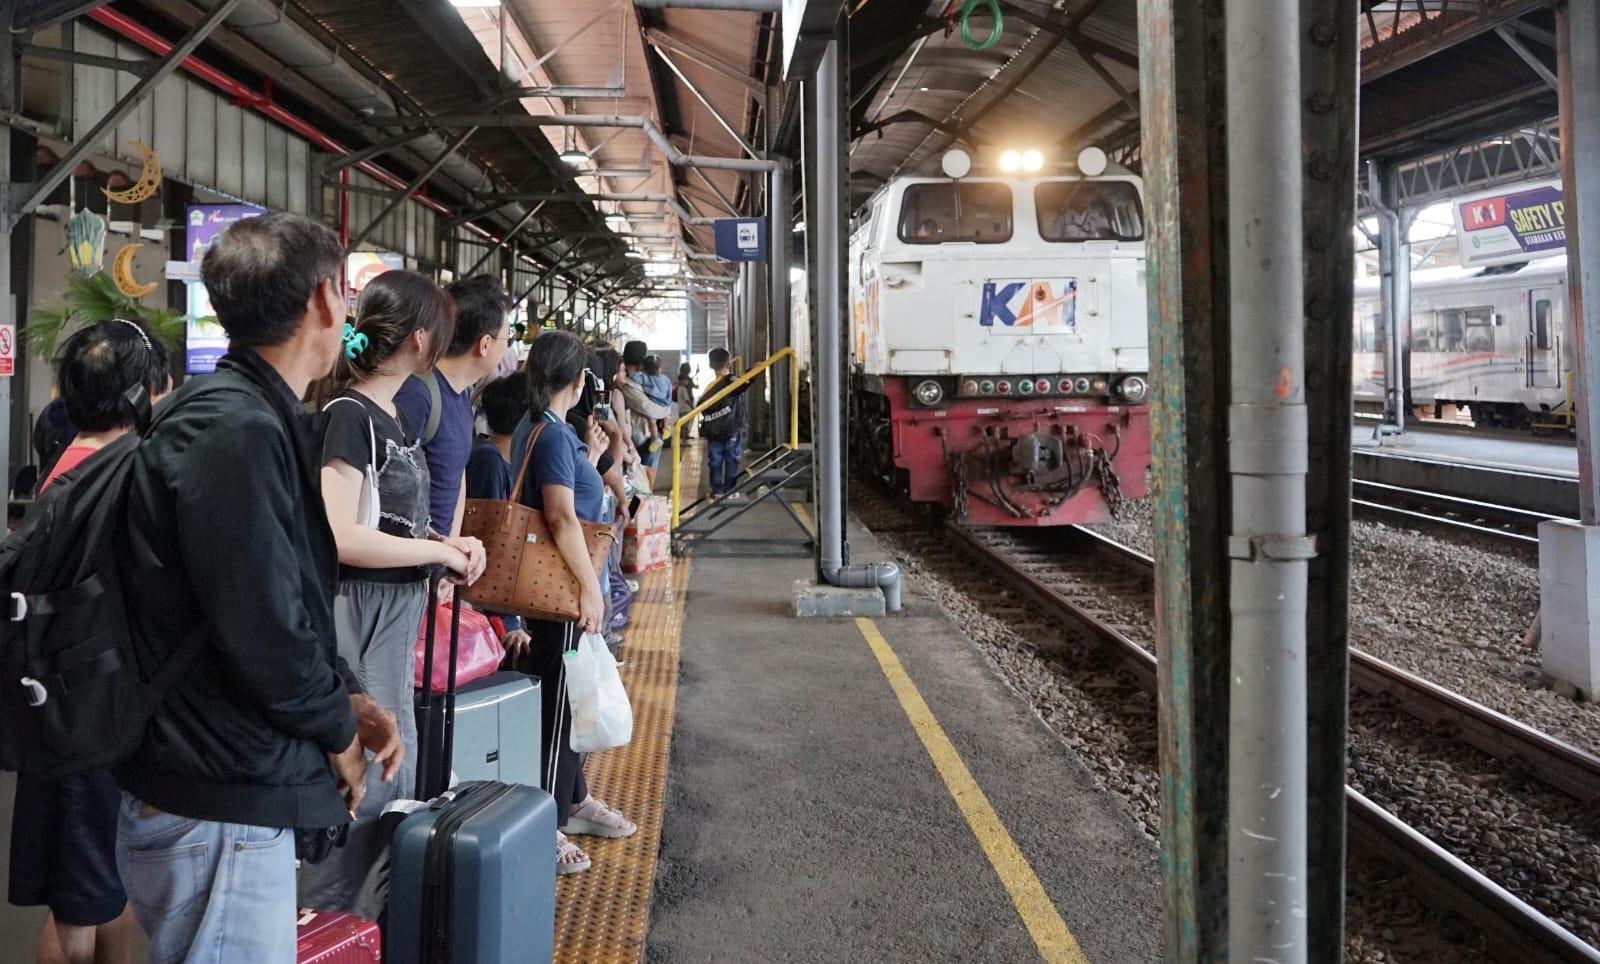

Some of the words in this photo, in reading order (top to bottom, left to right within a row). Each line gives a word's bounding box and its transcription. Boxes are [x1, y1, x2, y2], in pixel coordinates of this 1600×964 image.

[1472, 203, 1497, 224] KAI
[1509, 203, 1555, 233] SAFETY
[979, 281, 1077, 327] KAI
